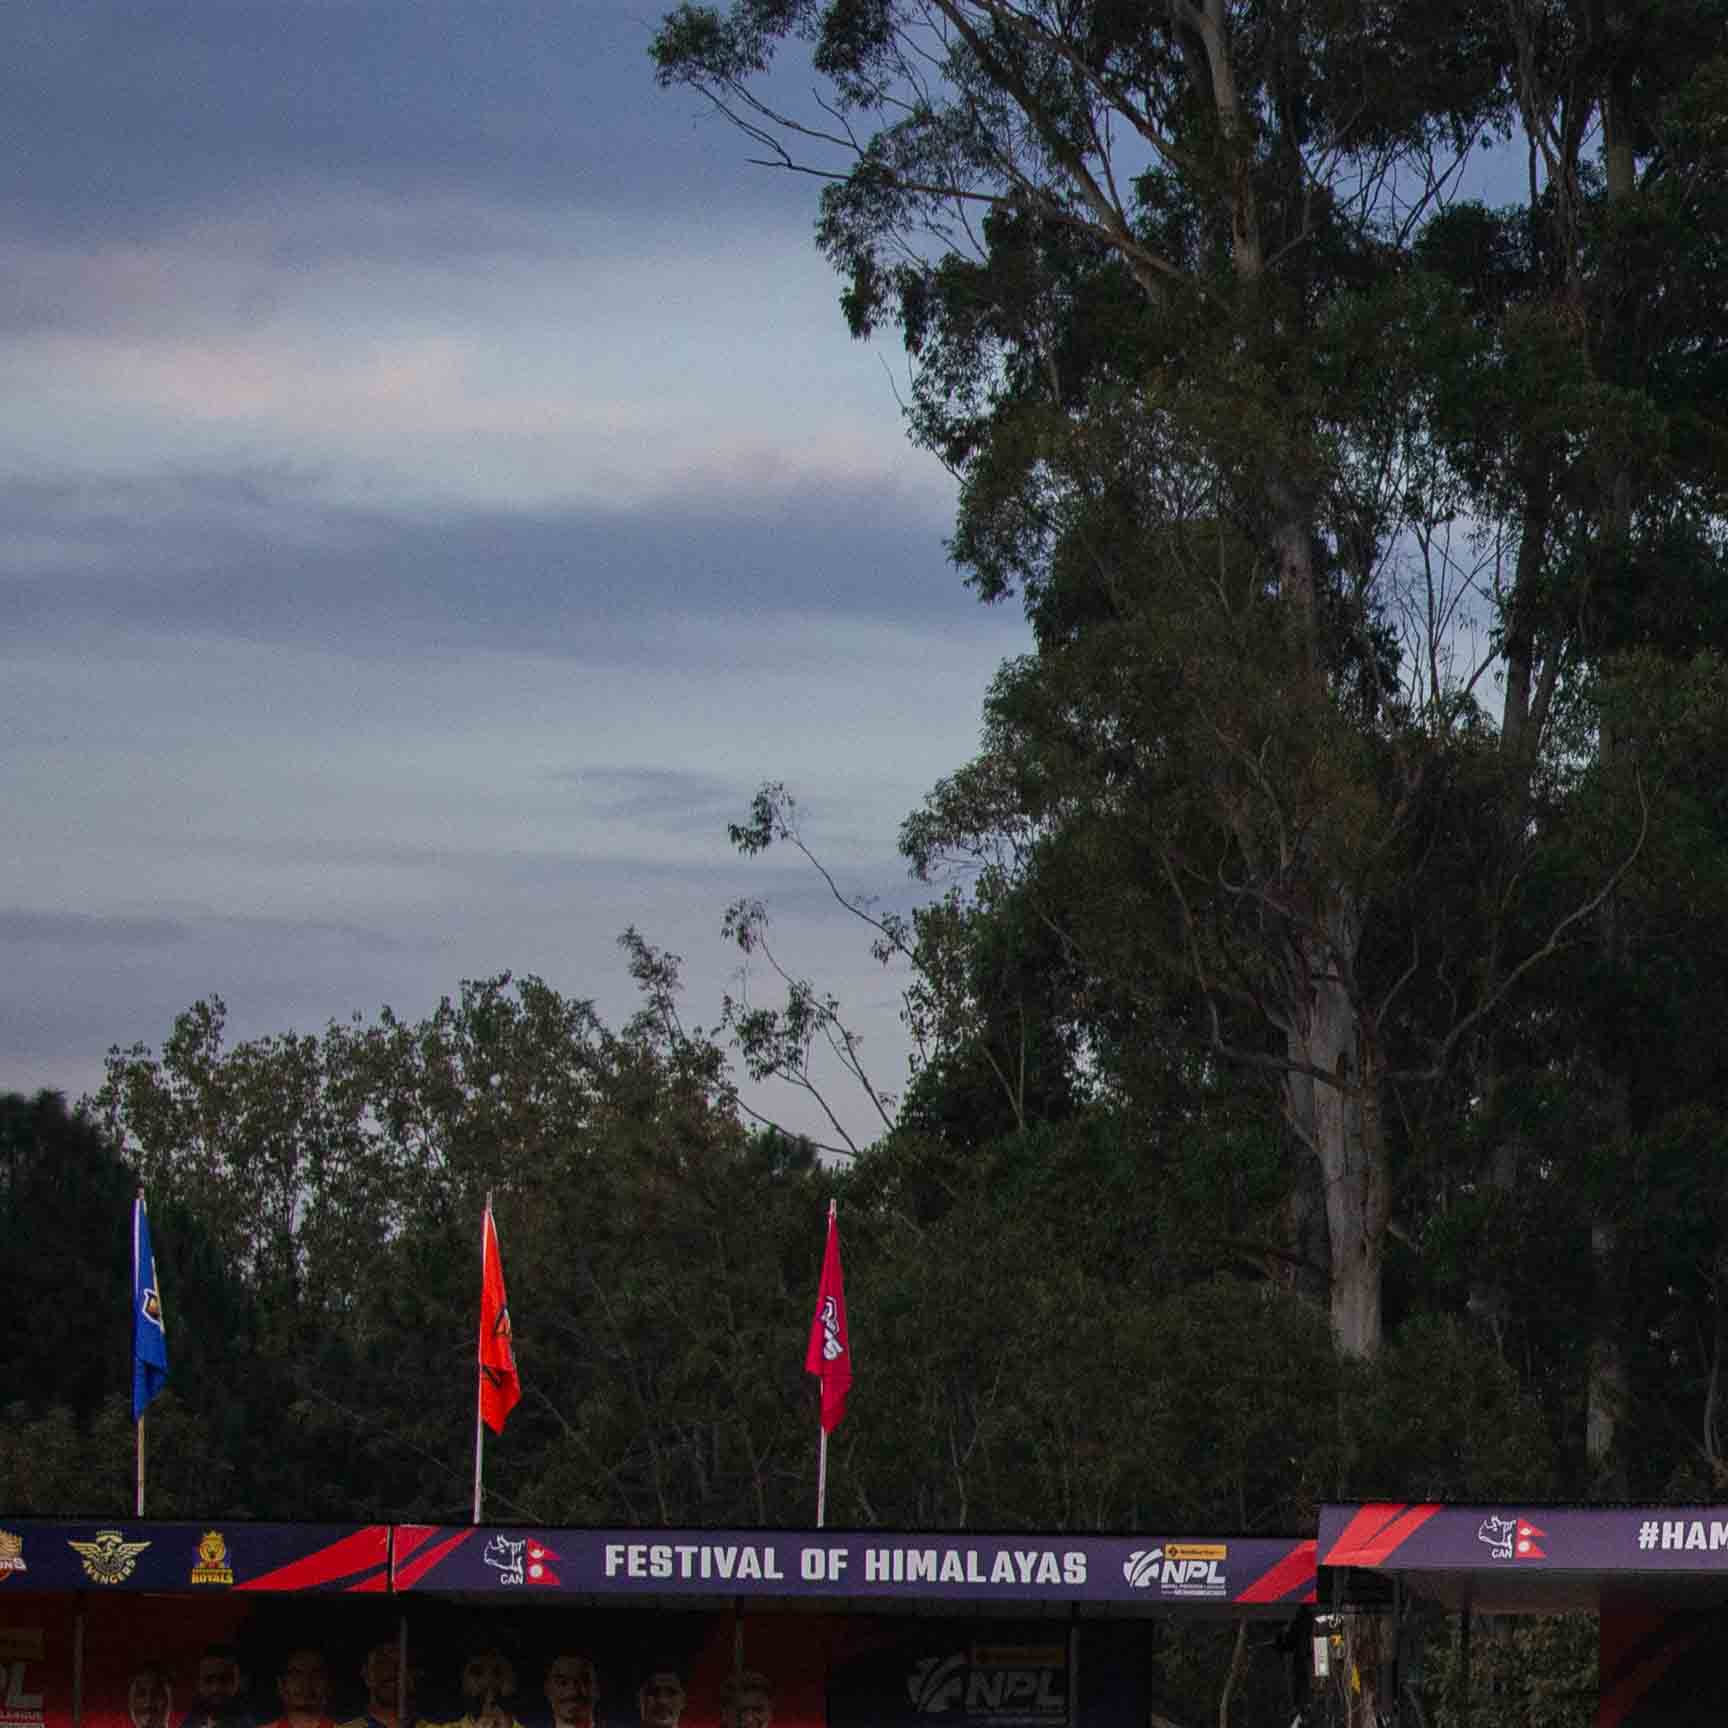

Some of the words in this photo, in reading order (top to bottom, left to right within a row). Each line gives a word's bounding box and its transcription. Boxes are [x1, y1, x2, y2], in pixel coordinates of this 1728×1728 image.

[1491, 1548, 1514, 1560] CAN
[605, 1544, 784, 1581] FESTIVAL
[801, 1549, 848, 1581] OF
[865, 1549, 1087, 1585] HIMALAYAS
[1160, 1560, 1227, 1585] NPL
[500, 1573, 524, 1585] CAN
